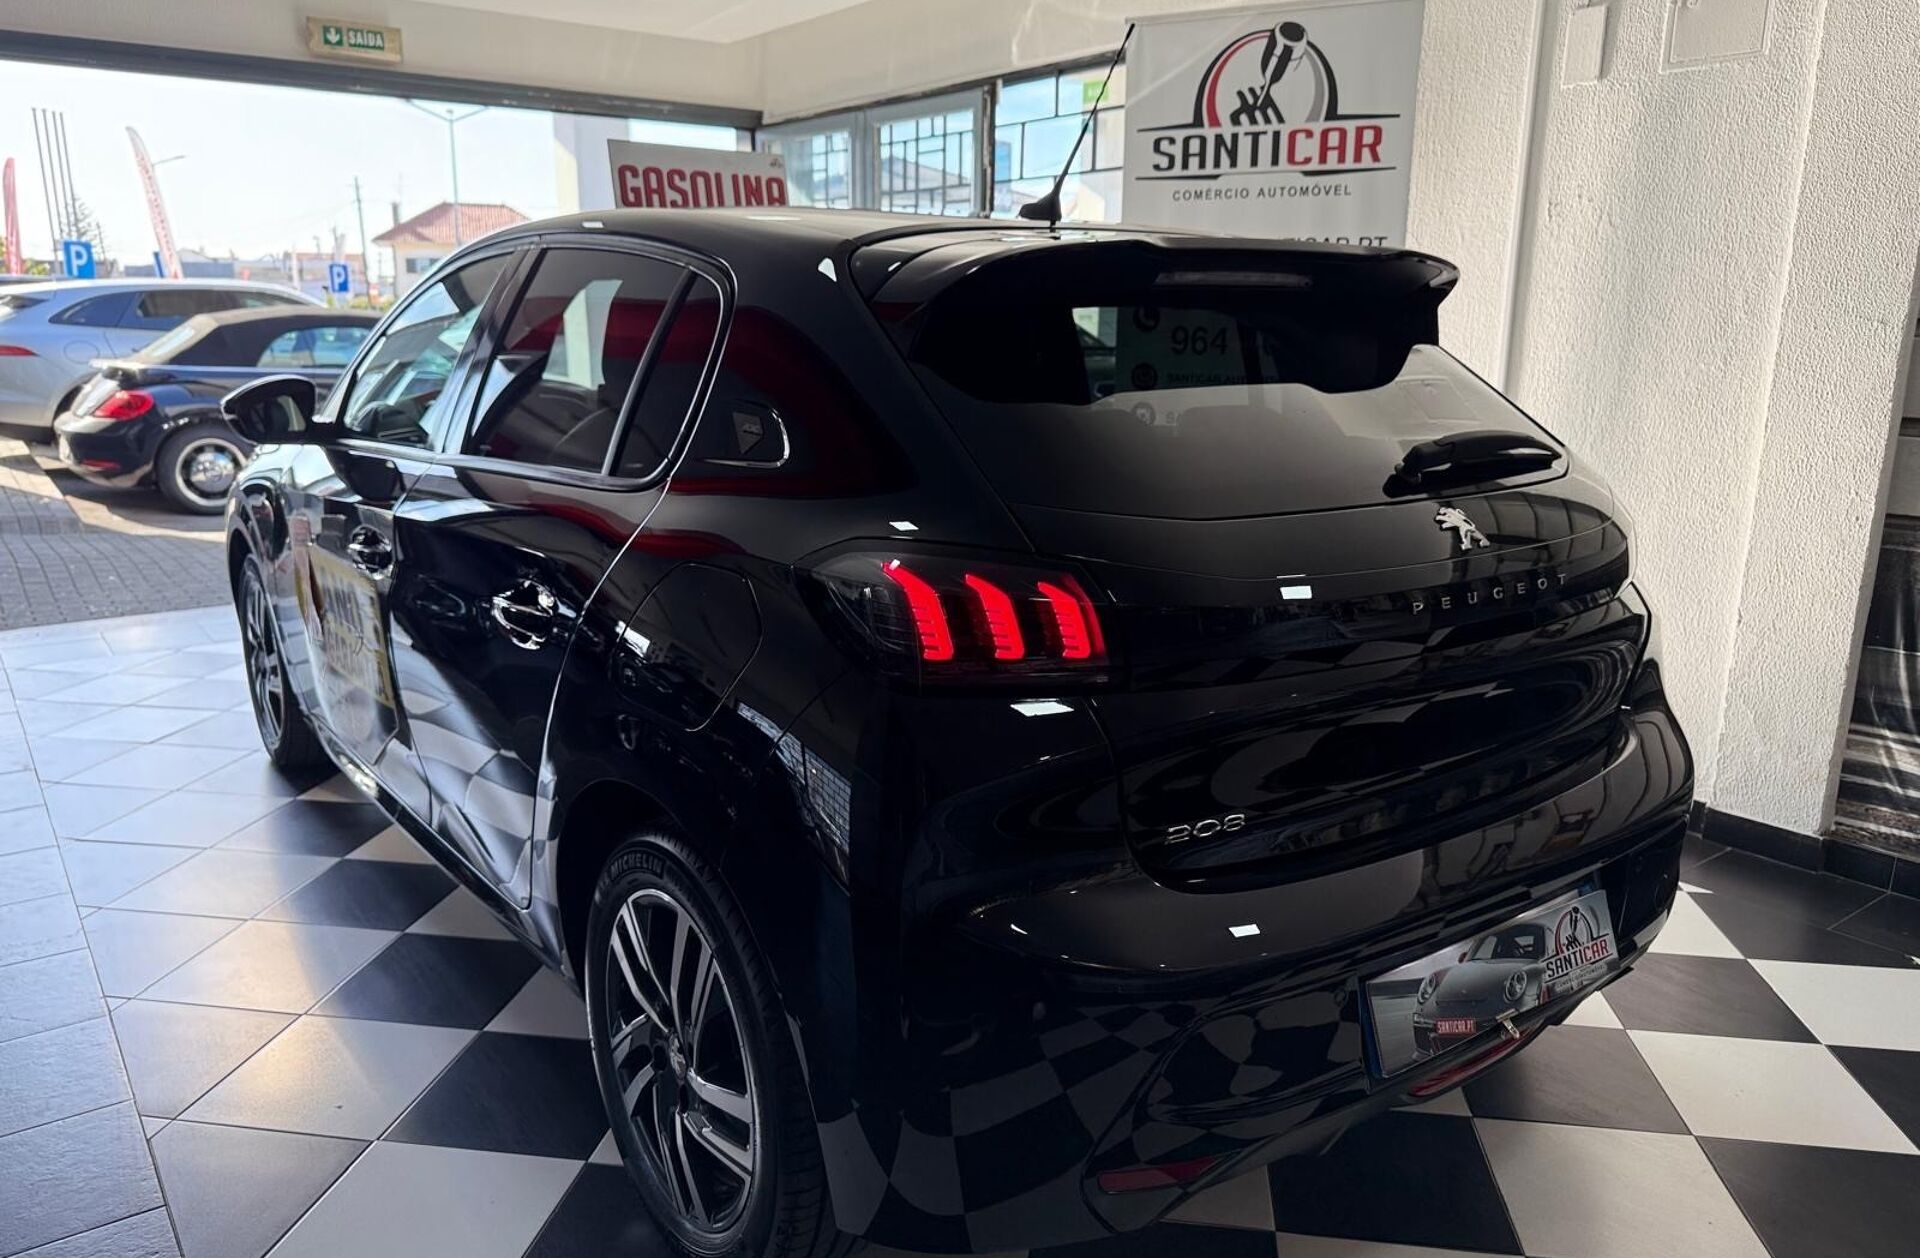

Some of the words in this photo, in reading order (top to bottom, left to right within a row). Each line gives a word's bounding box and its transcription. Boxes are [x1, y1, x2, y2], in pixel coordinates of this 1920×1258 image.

[348, 30, 384, 48] SAÍDA
[1152, 125, 1382, 172] SANTICAR
[618, 164, 787, 207] GASOLINA
[1172, 186, 1250, 201] COMÉRCIO
[1257, 184, 1352, 199] AUTOMÓVEL
[70, 246, 88, 276] P
[333, 267, 346, 290] P
[1171, 325, 1229, 356] 964
[1412, 573, 1567, 615] PEUGEOT
[1164, 814, 1245, 845] 208
[610, 853, 663, 881] MICHELIN
[1546, 938, 1609, 979] SANTICAR
